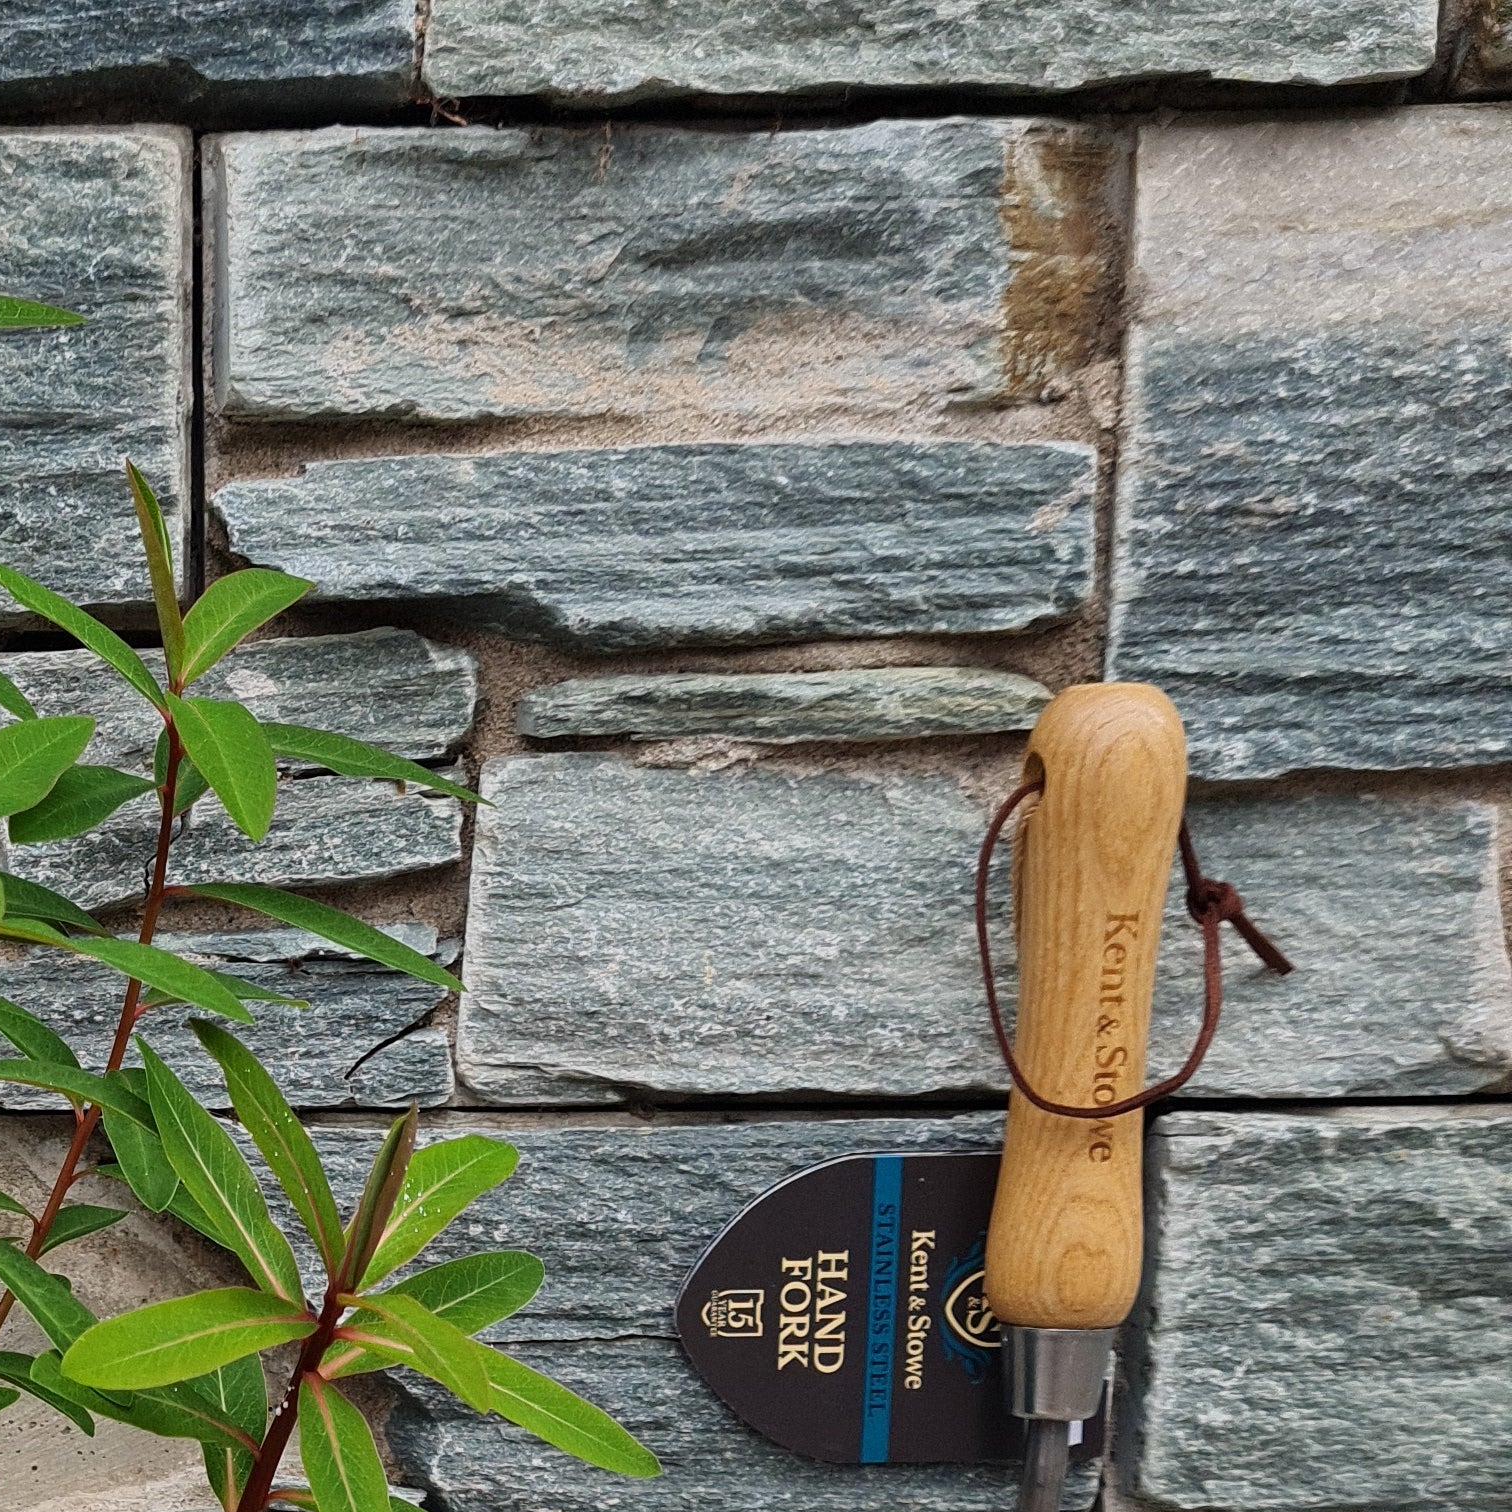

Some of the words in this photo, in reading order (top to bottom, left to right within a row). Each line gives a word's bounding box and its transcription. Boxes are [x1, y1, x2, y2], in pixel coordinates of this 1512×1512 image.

[1099, 911, 1140, 1007] Kent
[1097, 1014, 1121, 1036] &
[1088, 1046, 1128, 1163] Stowe
[871, 1202, 896, 1336] STAINLESS
[909, 1229, 936, 1292] Kent
[718, 1299, 728, 1328] YEAR
[728, 1298, 754, 1328] 15
[777, 1256, 813, 1371] FORK
[813, 1249, 849, 1374] HAND
[909, 1296, 927, 1312] &
[867, 1342, 893, 1417] STEEL
[903, 1315, 932, 1390] Stowe
